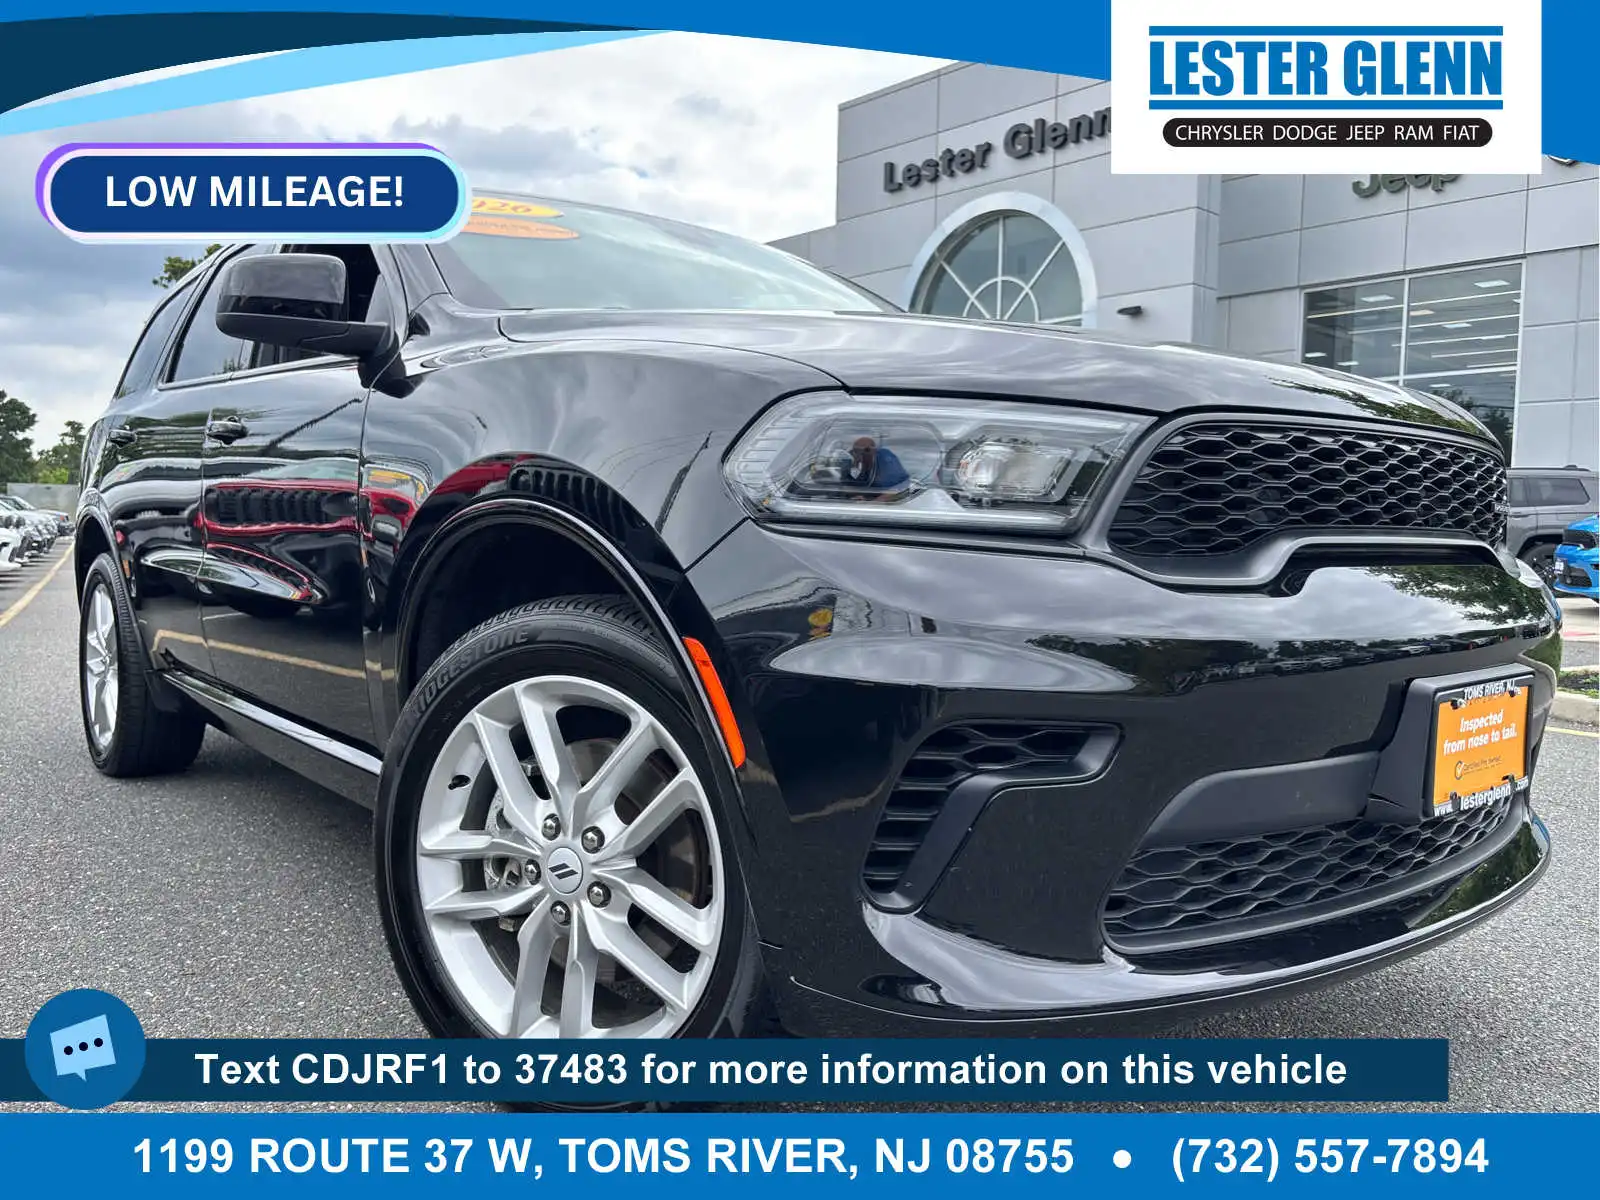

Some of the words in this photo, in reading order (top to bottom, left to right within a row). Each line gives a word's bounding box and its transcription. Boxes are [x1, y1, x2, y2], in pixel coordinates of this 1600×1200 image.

[883, 141, 992, 194] Lester
[1463, 684, 1484, 701] TOMS
[1460, 709, 1504, 733] Inspected
[1443, 738, 1466, 756] from
[1467, 733, 1489, 749] nose
[1490, 729, 1500, 743] to
[1502, 722, 1517, 740] tail.
[1460, 783, 1511, 811] lesterglenn
